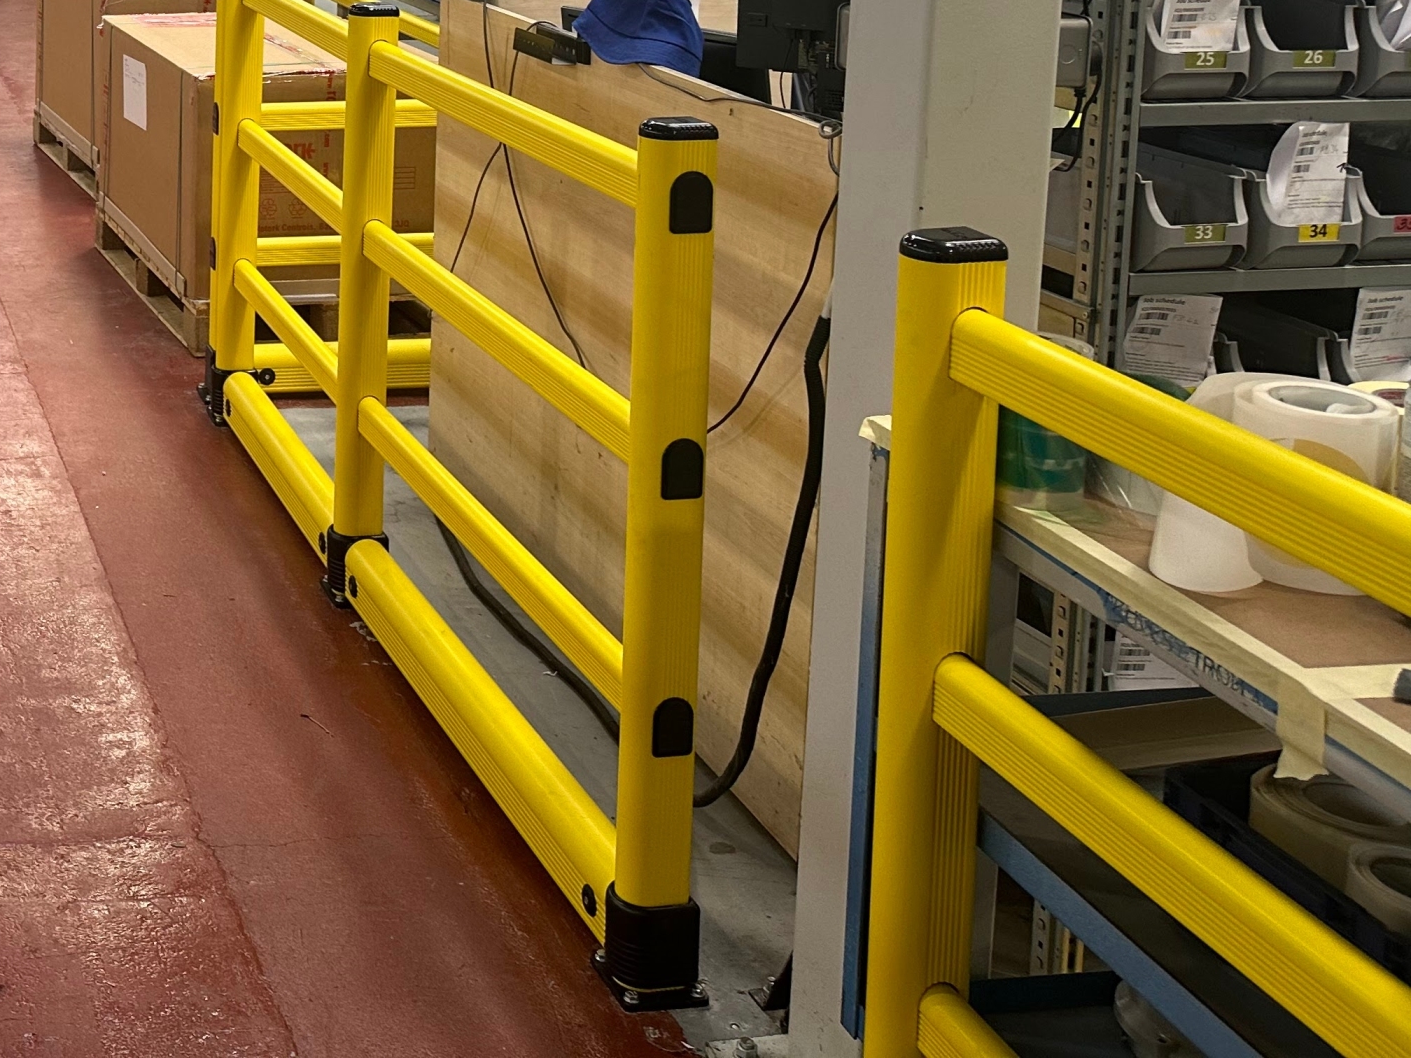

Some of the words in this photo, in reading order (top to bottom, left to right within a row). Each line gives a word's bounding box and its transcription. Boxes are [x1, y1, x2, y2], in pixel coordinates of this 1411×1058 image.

[1195, 51, 1215, 66] 25
[1303, 50, 1324, 64] 26
[1194, 224, 1213, 240] 33
[1309, 223, 1328, 239] 34
